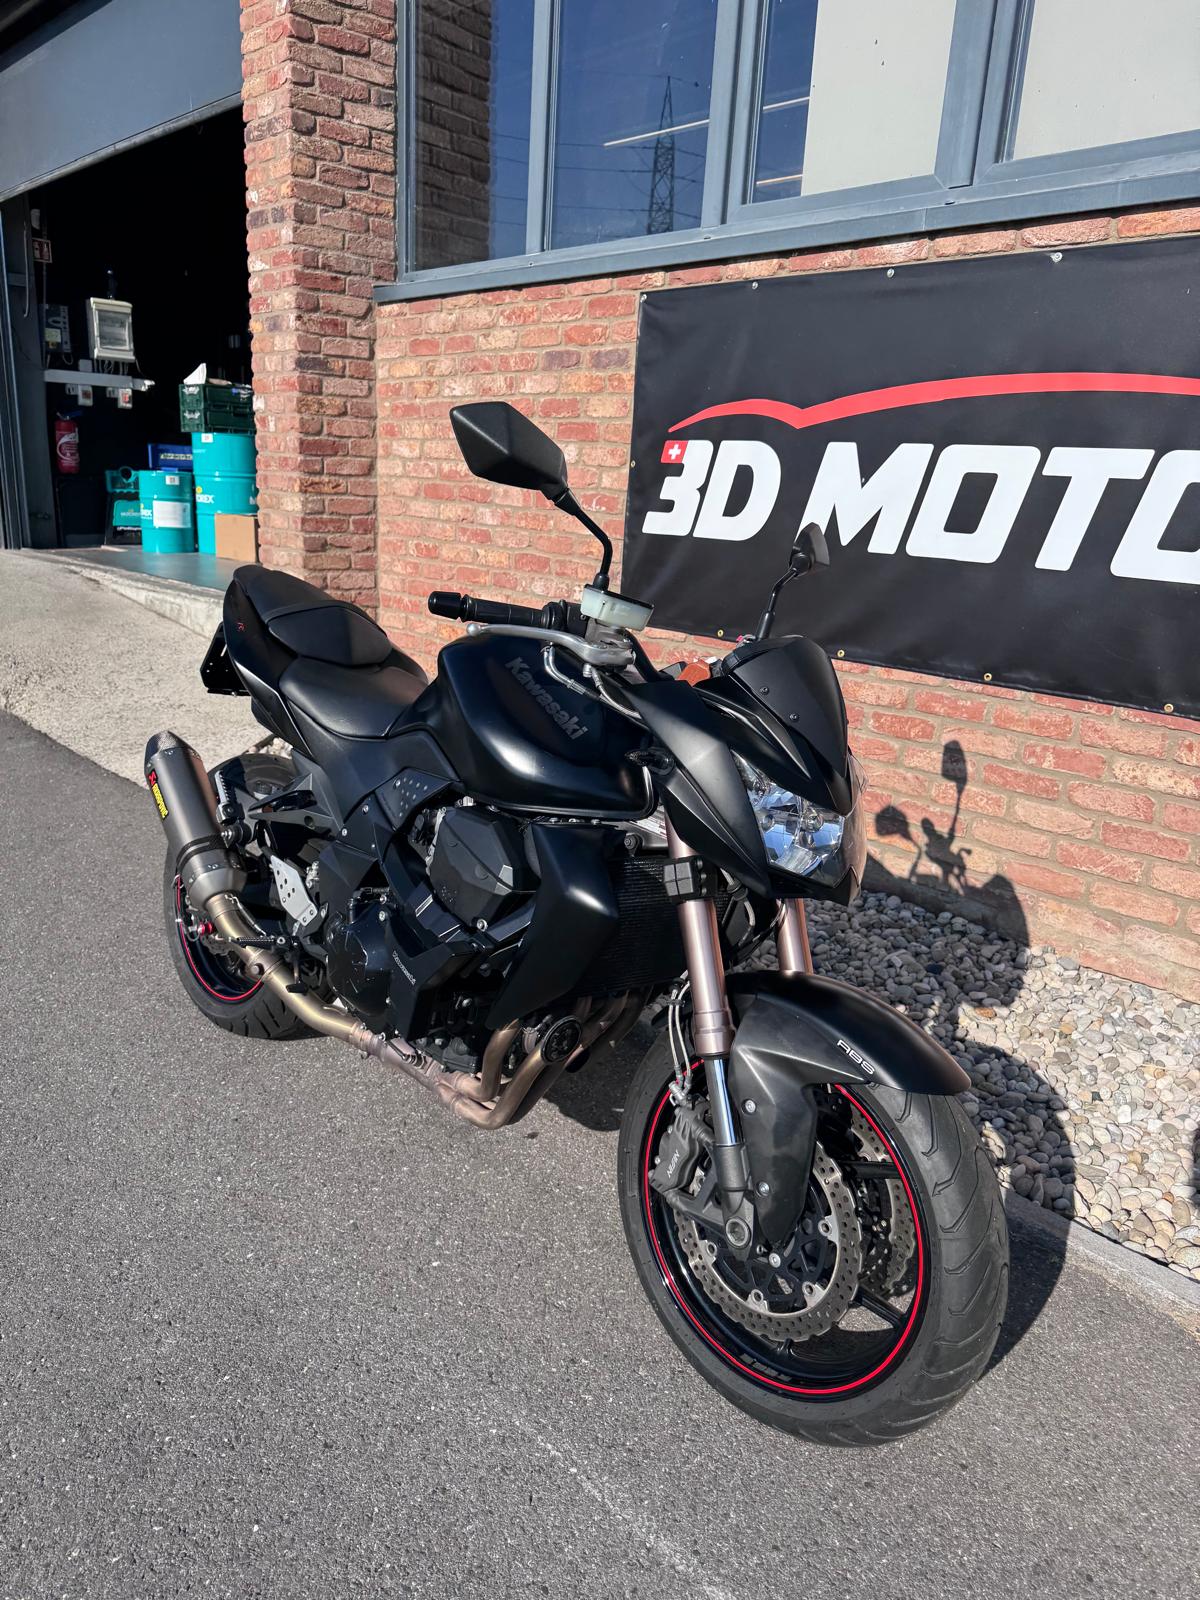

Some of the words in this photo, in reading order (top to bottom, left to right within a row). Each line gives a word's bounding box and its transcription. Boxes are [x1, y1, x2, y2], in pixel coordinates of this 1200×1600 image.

[642, 440, 782, 541] 3D
[504, 656, 589, 740] Kawasaki
[837, 1039, 876, 1075] ABS
